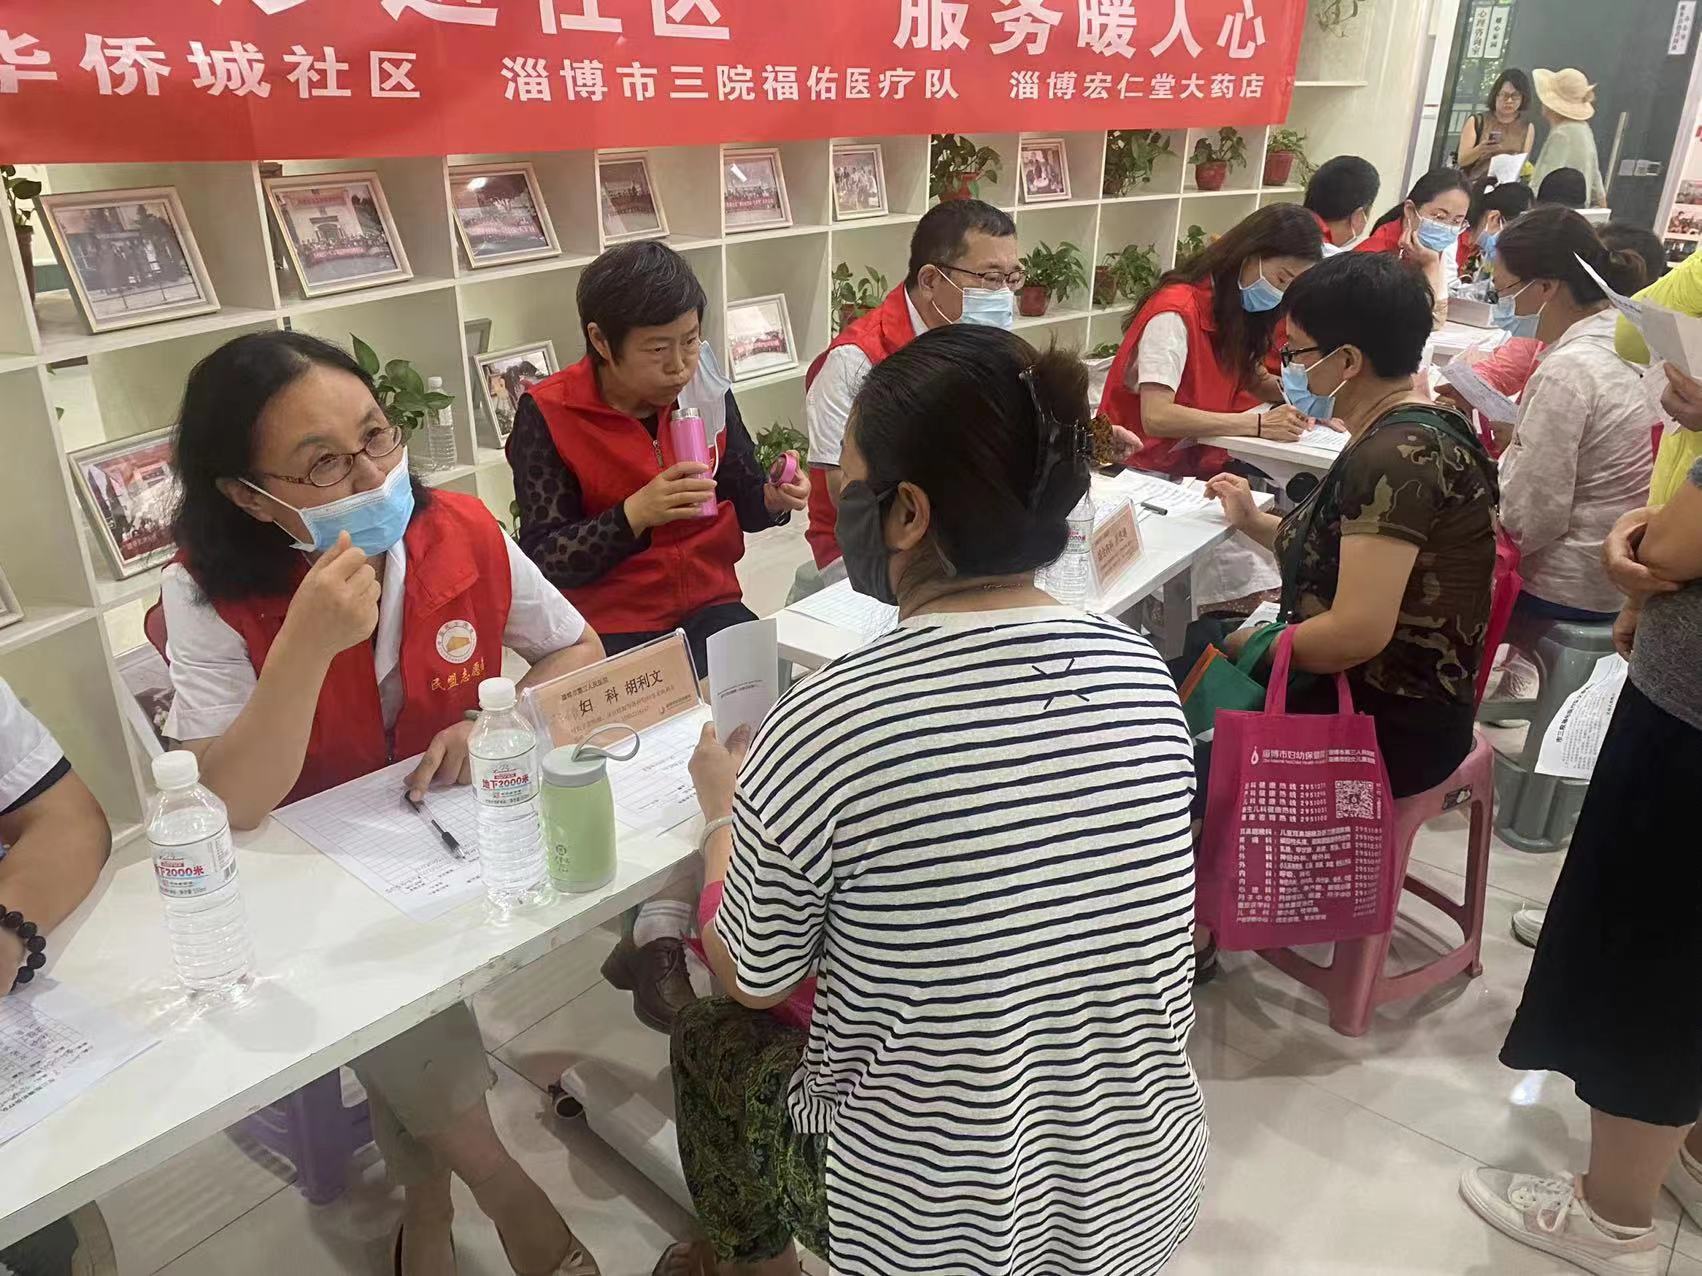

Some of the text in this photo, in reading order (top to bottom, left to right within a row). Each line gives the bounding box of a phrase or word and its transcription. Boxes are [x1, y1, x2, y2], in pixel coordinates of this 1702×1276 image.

[500, 57, 960, 101] 淄博市三院福佑医疗队
[1009, 70, 1265, 100] 淄博宏仁堂大药店
[625, 669, 663, 696] 胡利文
